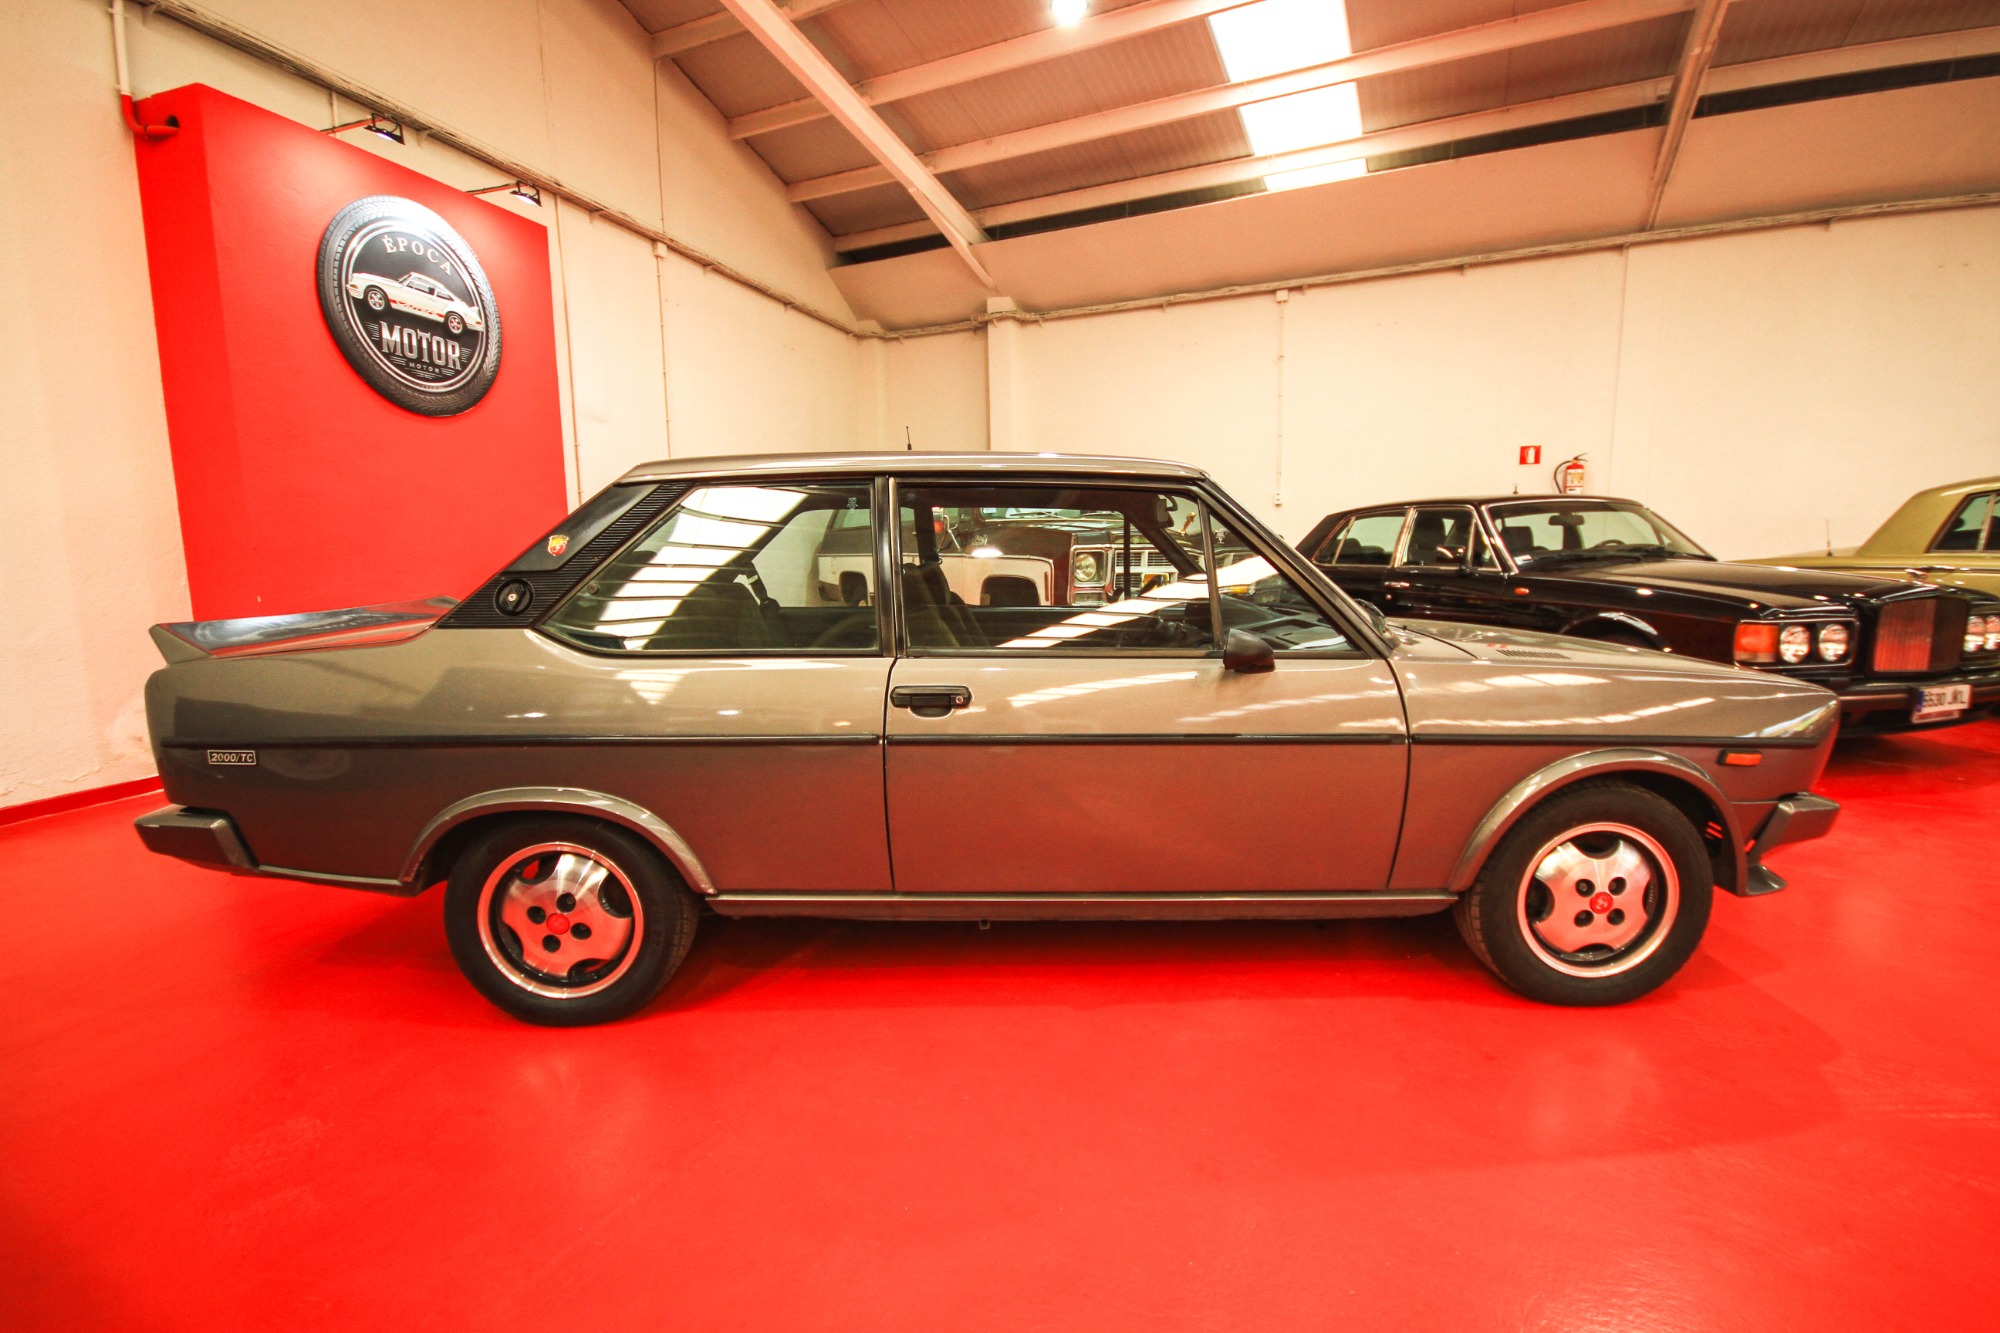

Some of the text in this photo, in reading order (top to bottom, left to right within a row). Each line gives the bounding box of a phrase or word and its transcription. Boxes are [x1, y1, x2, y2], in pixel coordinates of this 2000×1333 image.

[382, 235, 451, 276] ÉPOCA
[379, 320, 462, 370] MOTOR
[408, 361, 440, 374] MOTOR
[211, 753, 253, 762] 2000/TC
